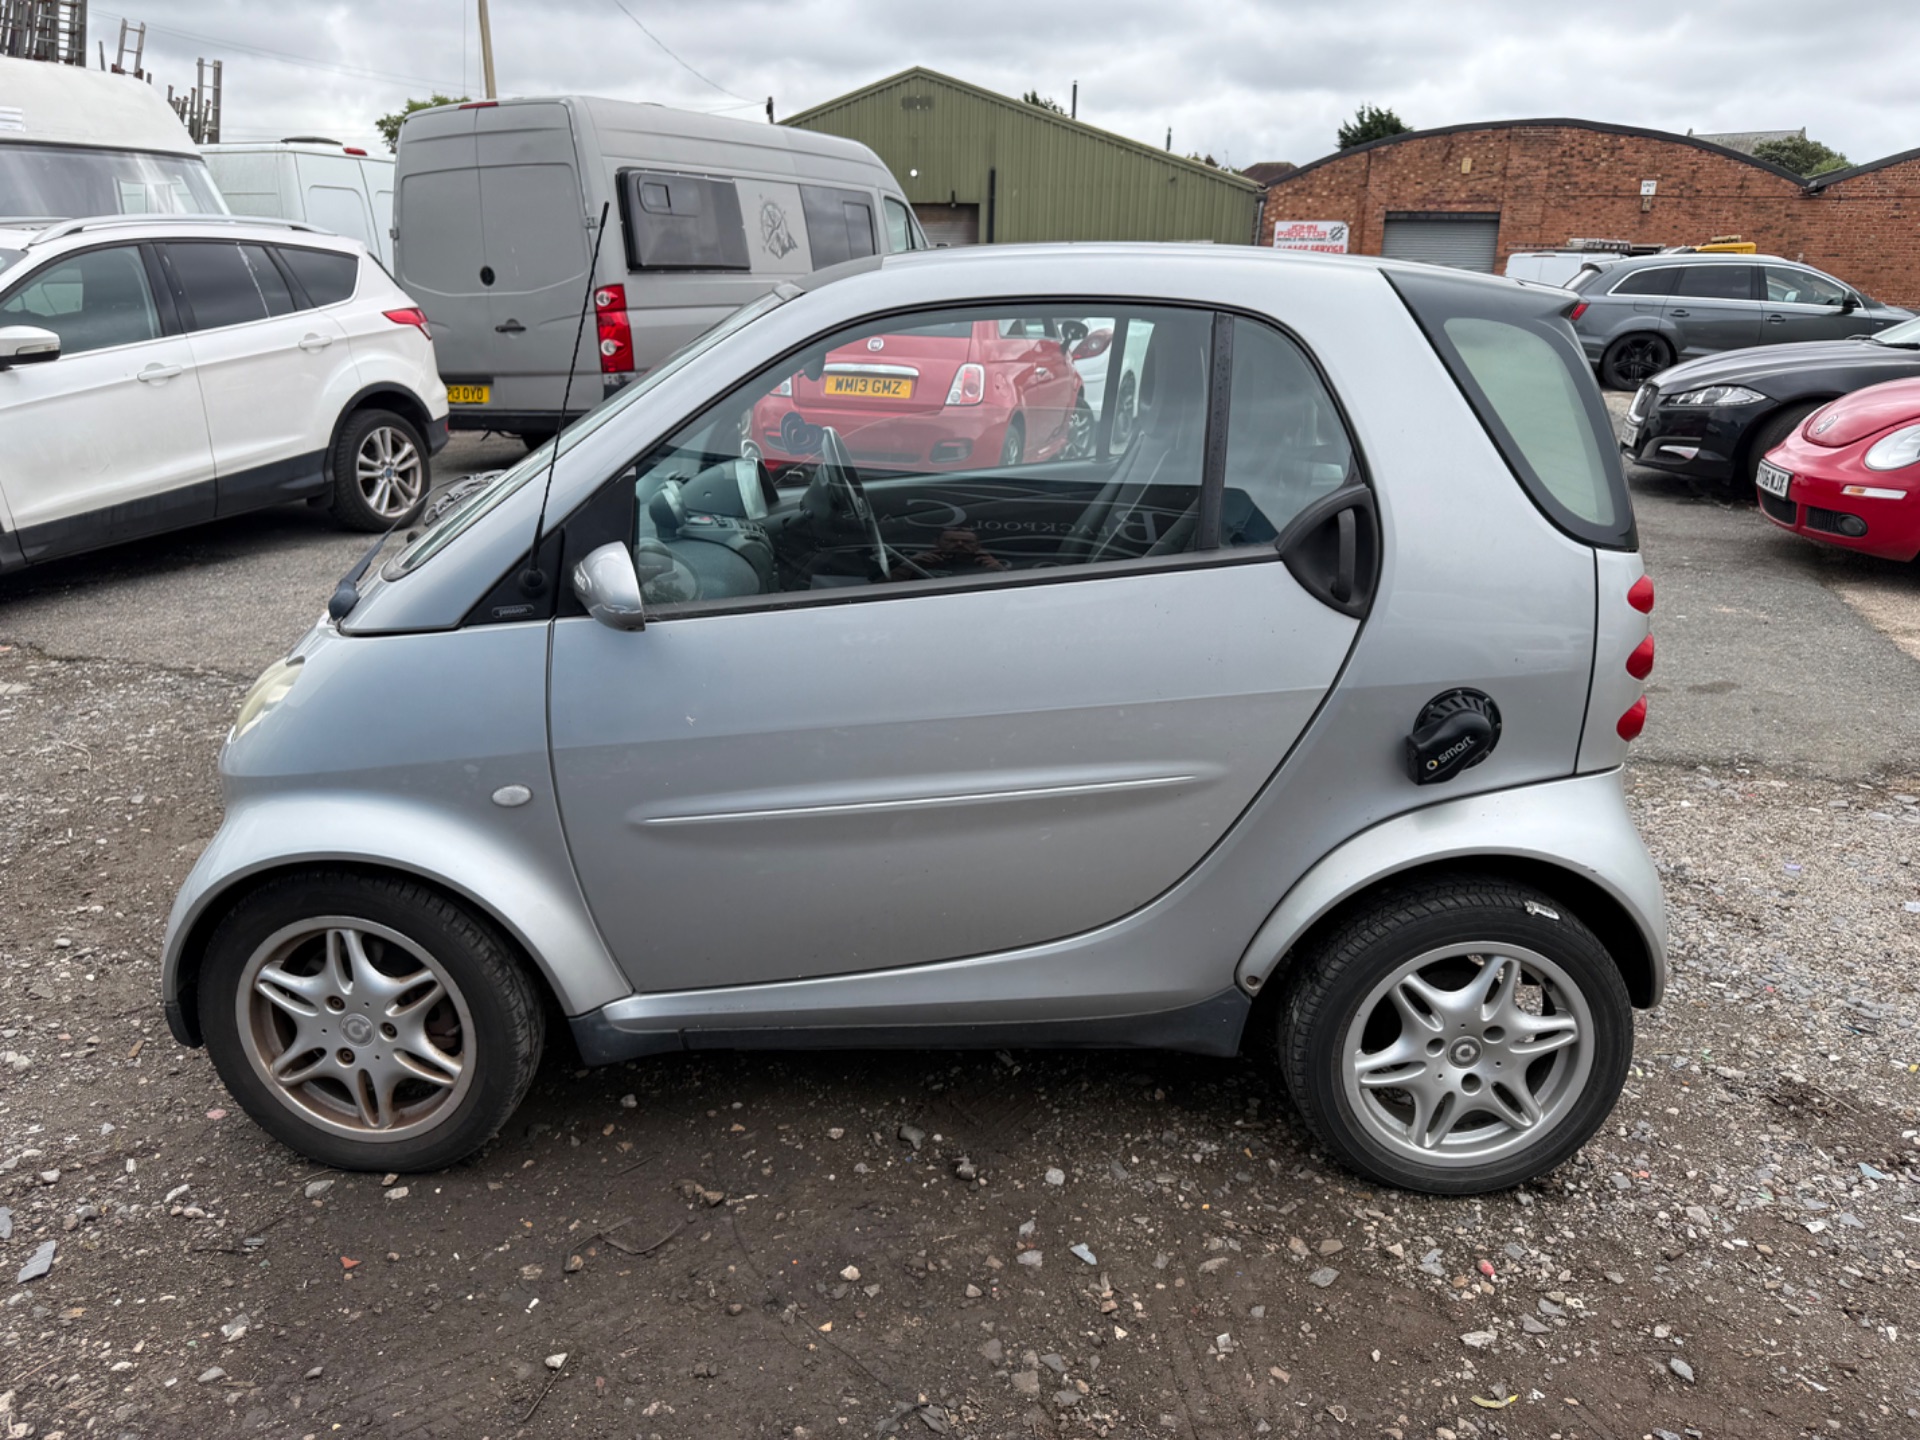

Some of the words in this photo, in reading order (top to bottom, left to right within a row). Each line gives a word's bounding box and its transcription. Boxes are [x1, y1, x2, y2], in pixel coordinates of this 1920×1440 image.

[1288, 224, 1318, 232] JOHN
[834, 377, 868, 393] WM13
[871, 379, 903, 395] GMZ
[1438, 735, 1475, 764] smart
